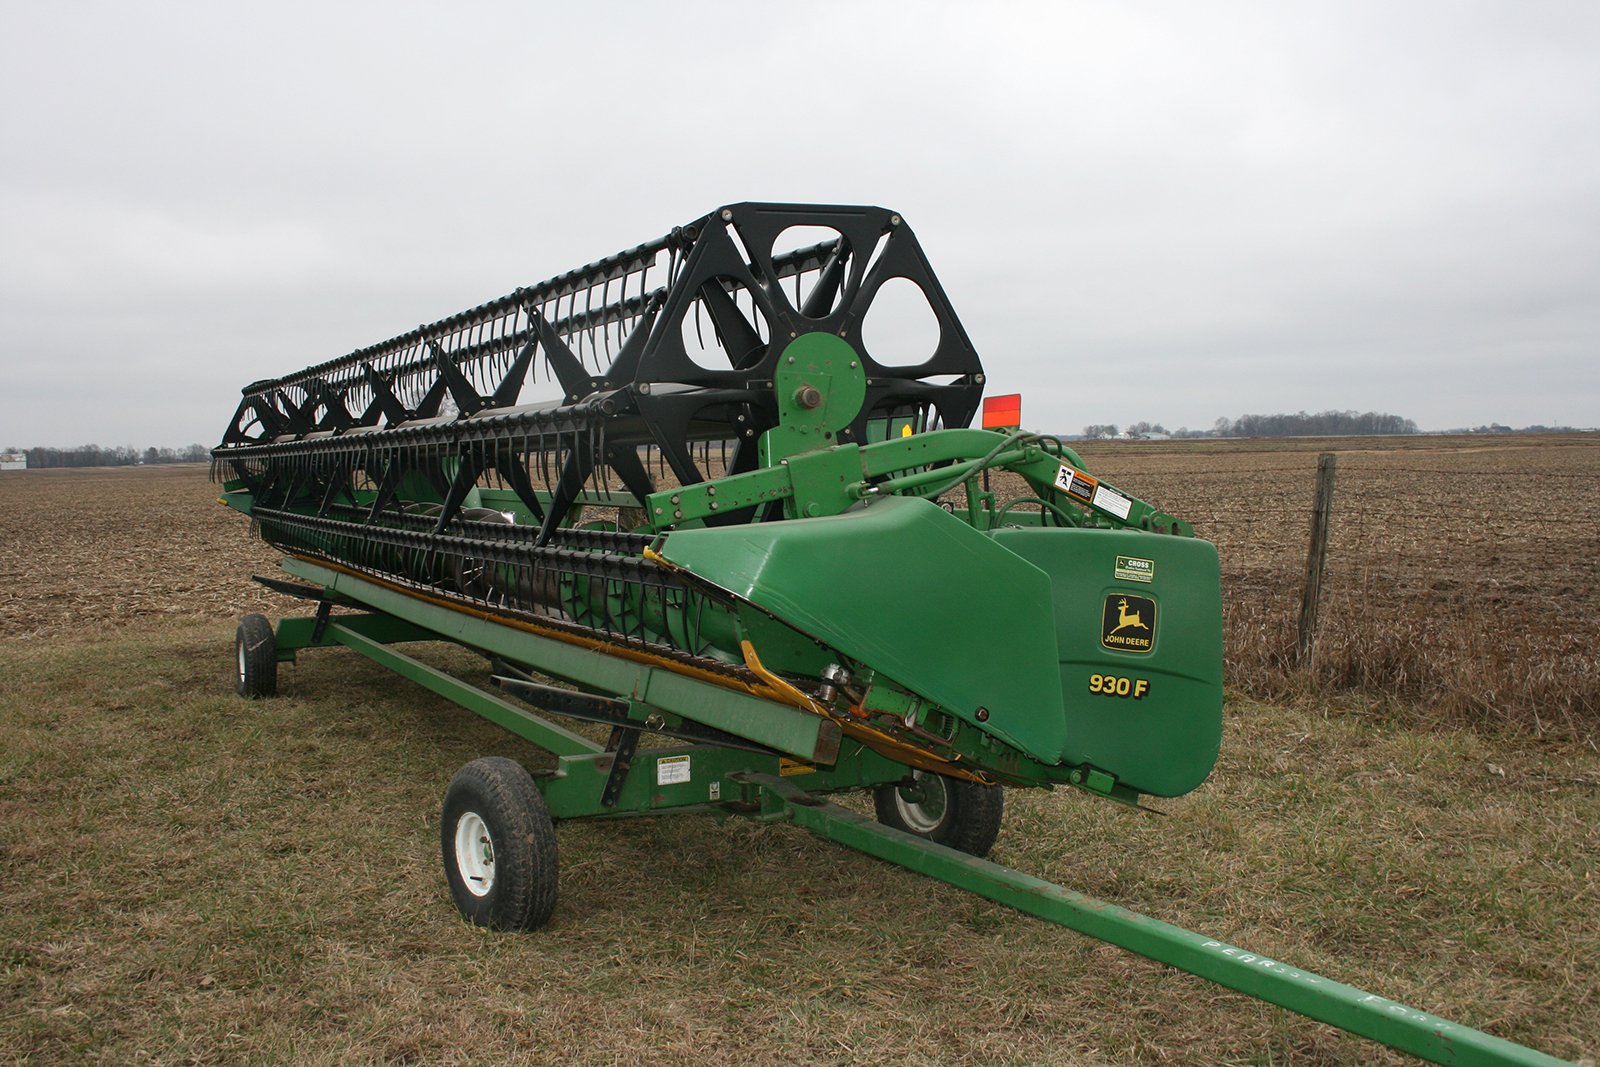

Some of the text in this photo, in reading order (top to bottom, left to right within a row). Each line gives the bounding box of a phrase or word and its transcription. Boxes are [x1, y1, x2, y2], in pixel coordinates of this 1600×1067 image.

[1127, 560, 1150, 569] CROSS
[1104, 635, 1149, 647] JOHN DEERE
[1089, 674, 1149, 698] 930 F
